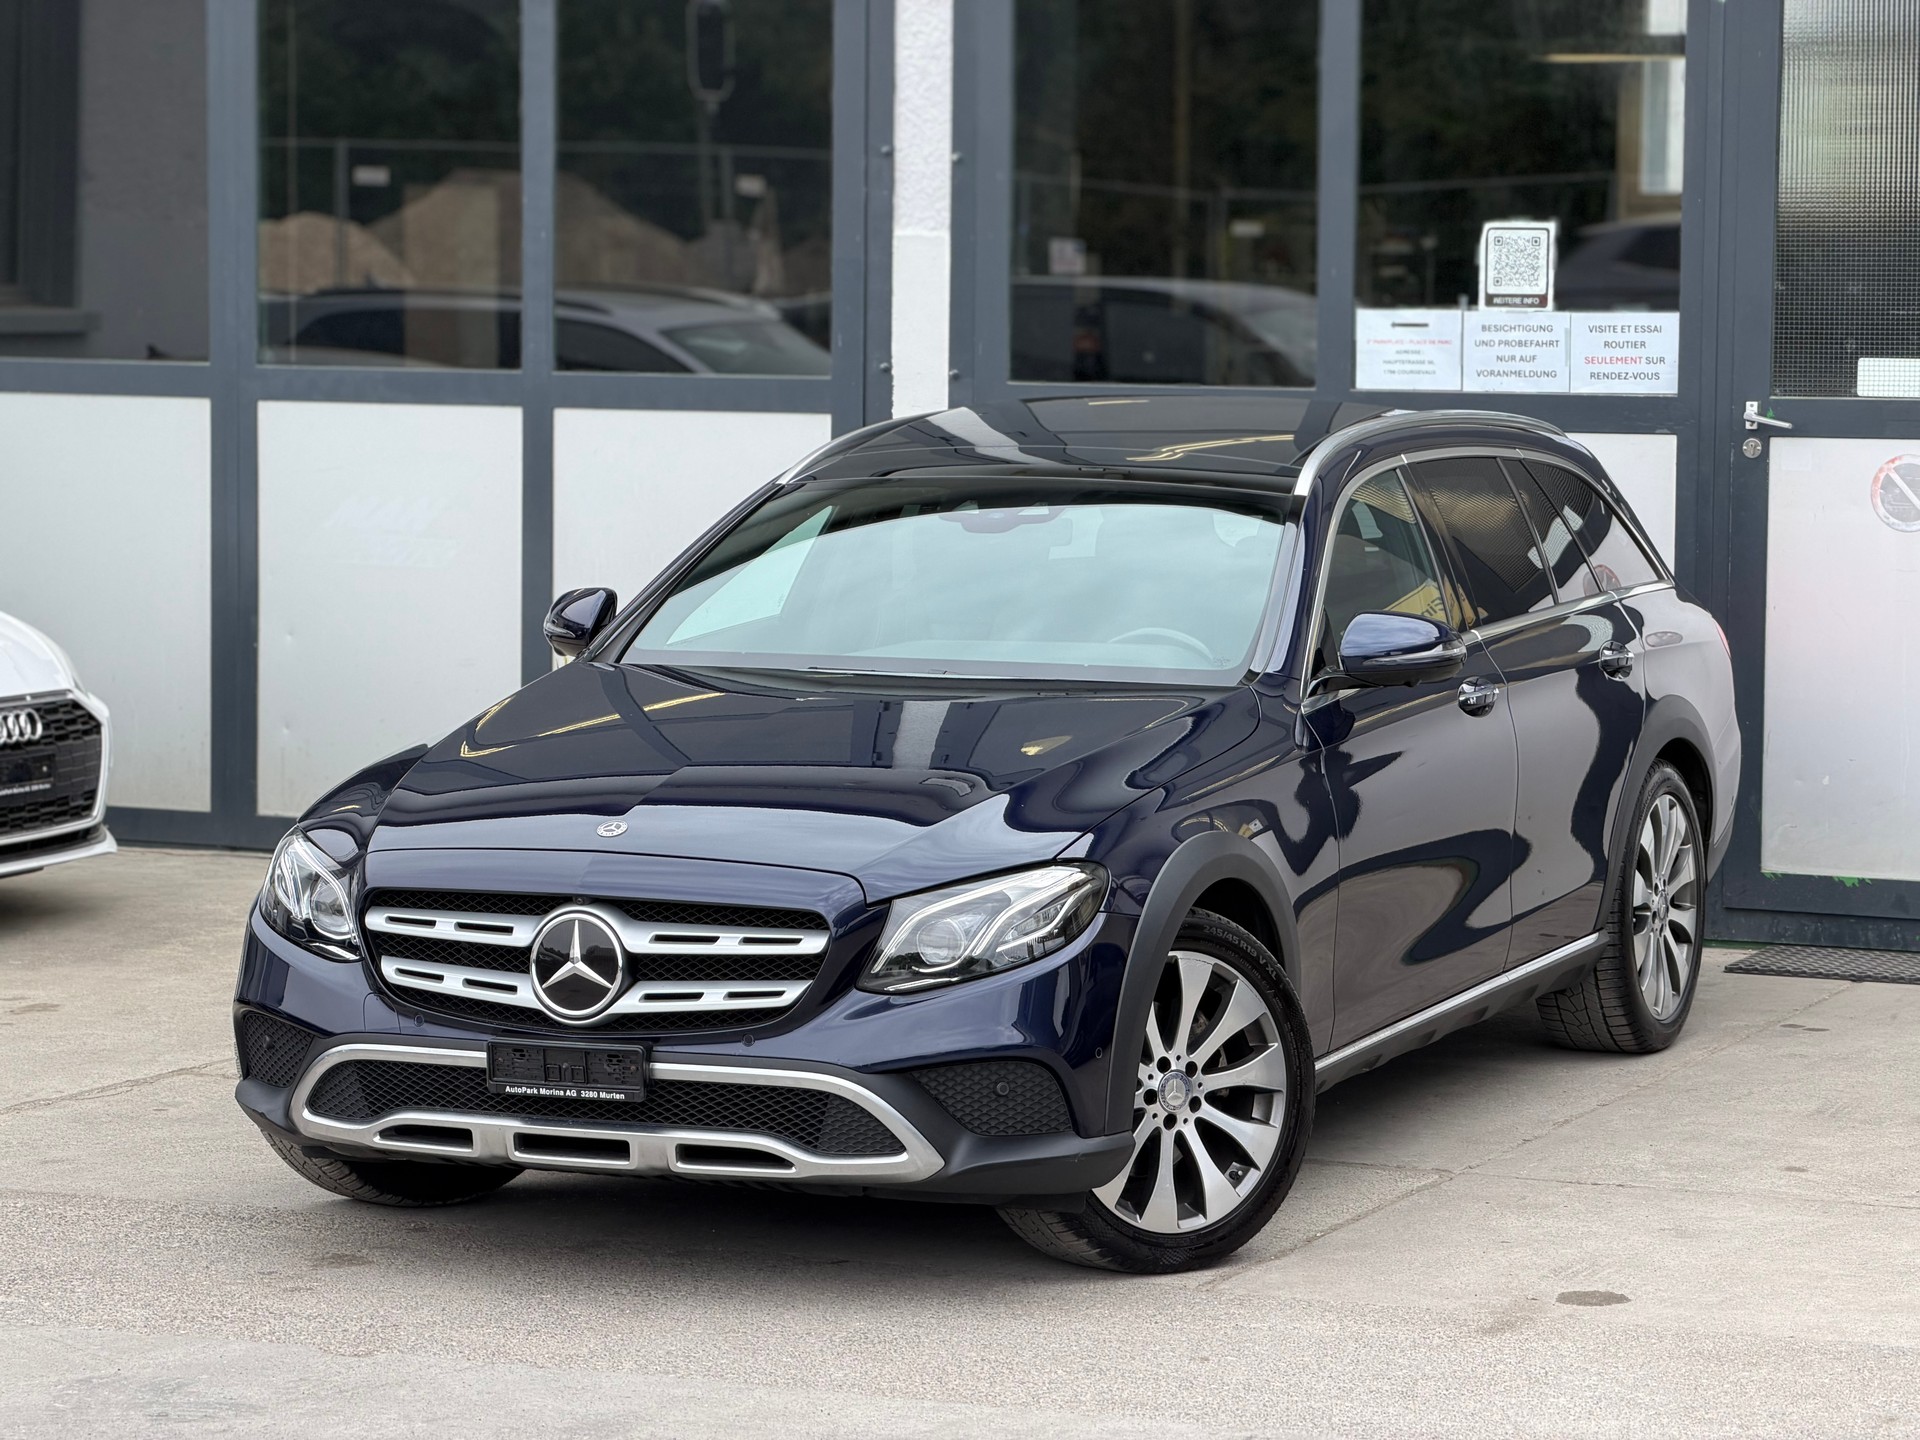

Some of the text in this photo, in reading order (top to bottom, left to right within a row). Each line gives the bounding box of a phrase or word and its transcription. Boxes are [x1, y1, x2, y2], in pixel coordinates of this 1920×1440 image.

[1493, 296, 1540, 305] WEITERE INFO
[1481, 324, 1554, 333] BESICHTIGUNG
[1588, 325, 1662, 333] VISITE ET ESSAI
[1474, 340, 1560, 348] UND PROBEFAHRT
[1603, 340, 1647, 349] ROUTIER
[1496, 355, 1538, 363] NUR AUF
[1584, 356, 1666, 365] SEULEMENT SUR
[1476, 369, 1557, 378] VORANMELDUNG
[1590, 372, 1660, 380] RENDEZ-VOUS
[1203, 925, 1240, 945] 245/45
[1239, 941, 1257, 957] R19
[505, 1085, 625, 1100] AutoPark Morina AG 3280 Murten
